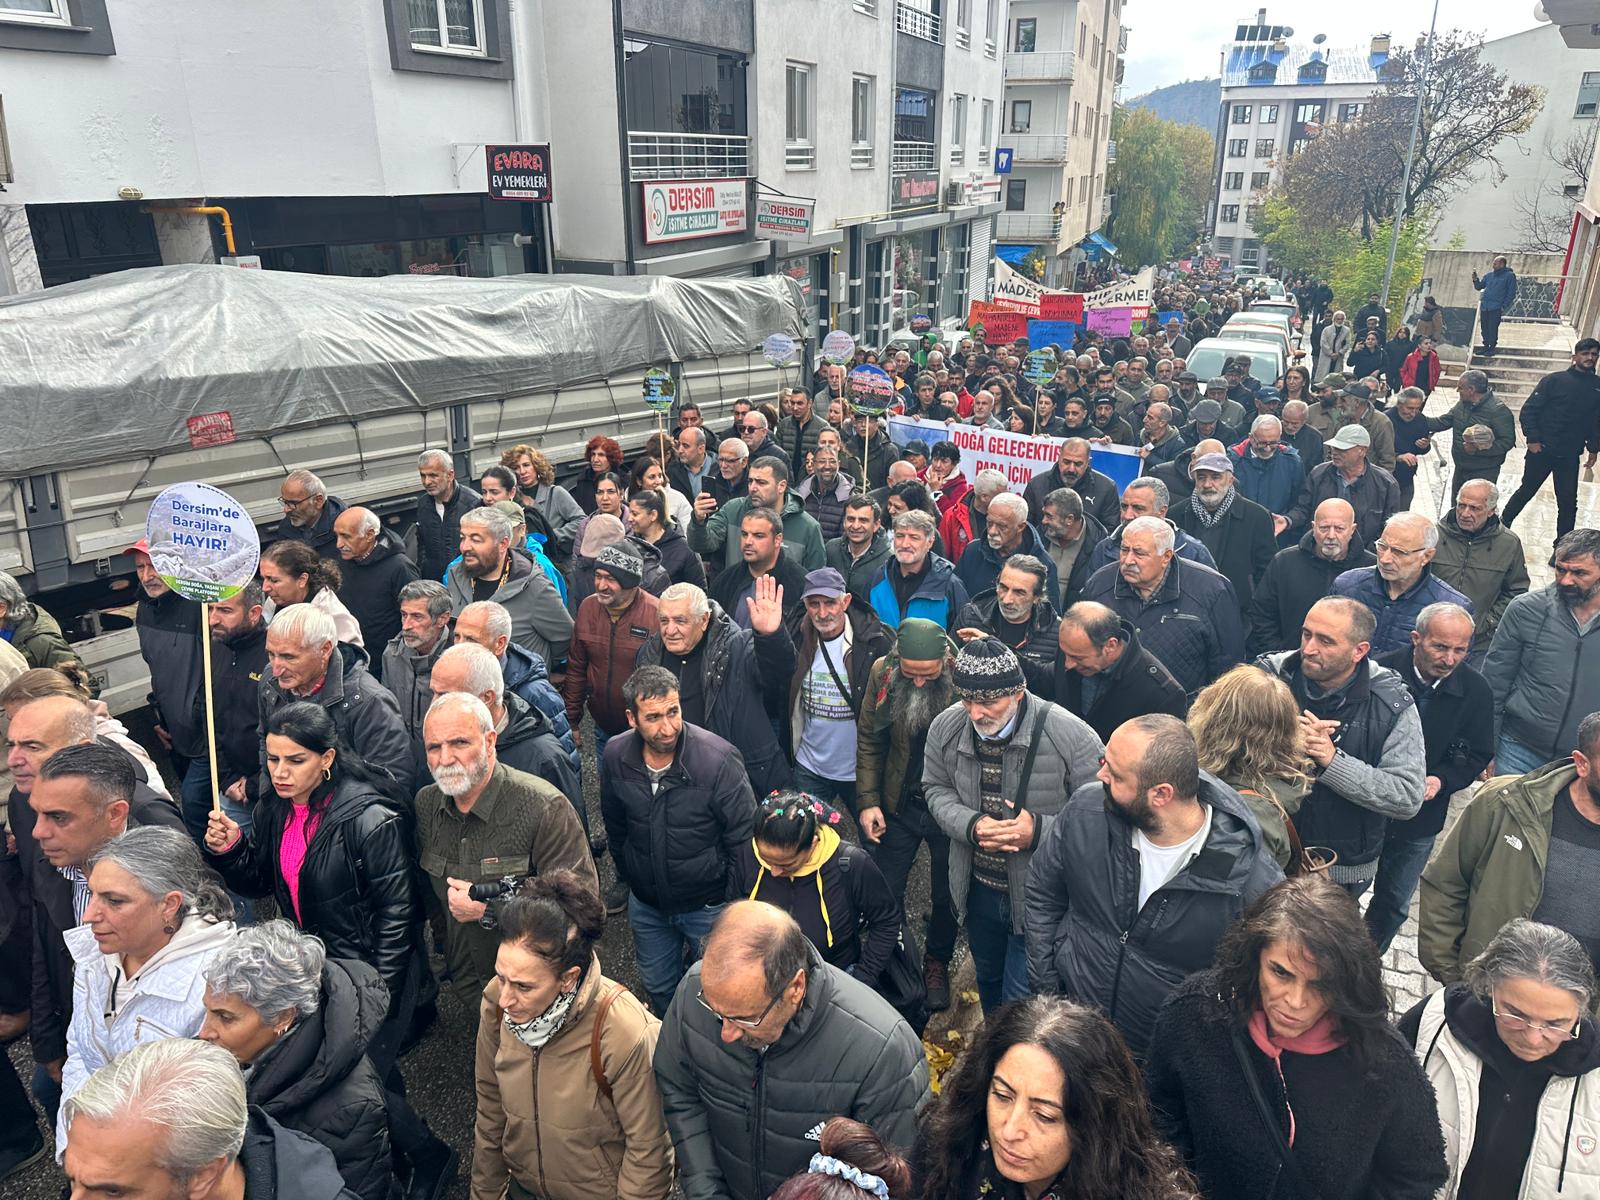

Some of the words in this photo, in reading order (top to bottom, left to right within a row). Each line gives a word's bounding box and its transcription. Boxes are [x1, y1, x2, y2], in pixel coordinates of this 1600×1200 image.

[494, 151, 542, 172] EVARA
[492, 175, 503, 187] EV
[504, 173, 546, 188] YEMEKLERİ
[953, 429, 985, 453] DOĞA
[1007, 461, 1033, 485] İÇİN
[172, 500, 240, 519] Dersim'de
[172, 516, 231, 533] Barajlara
[173, 532, 227, 551] HAYIR!
